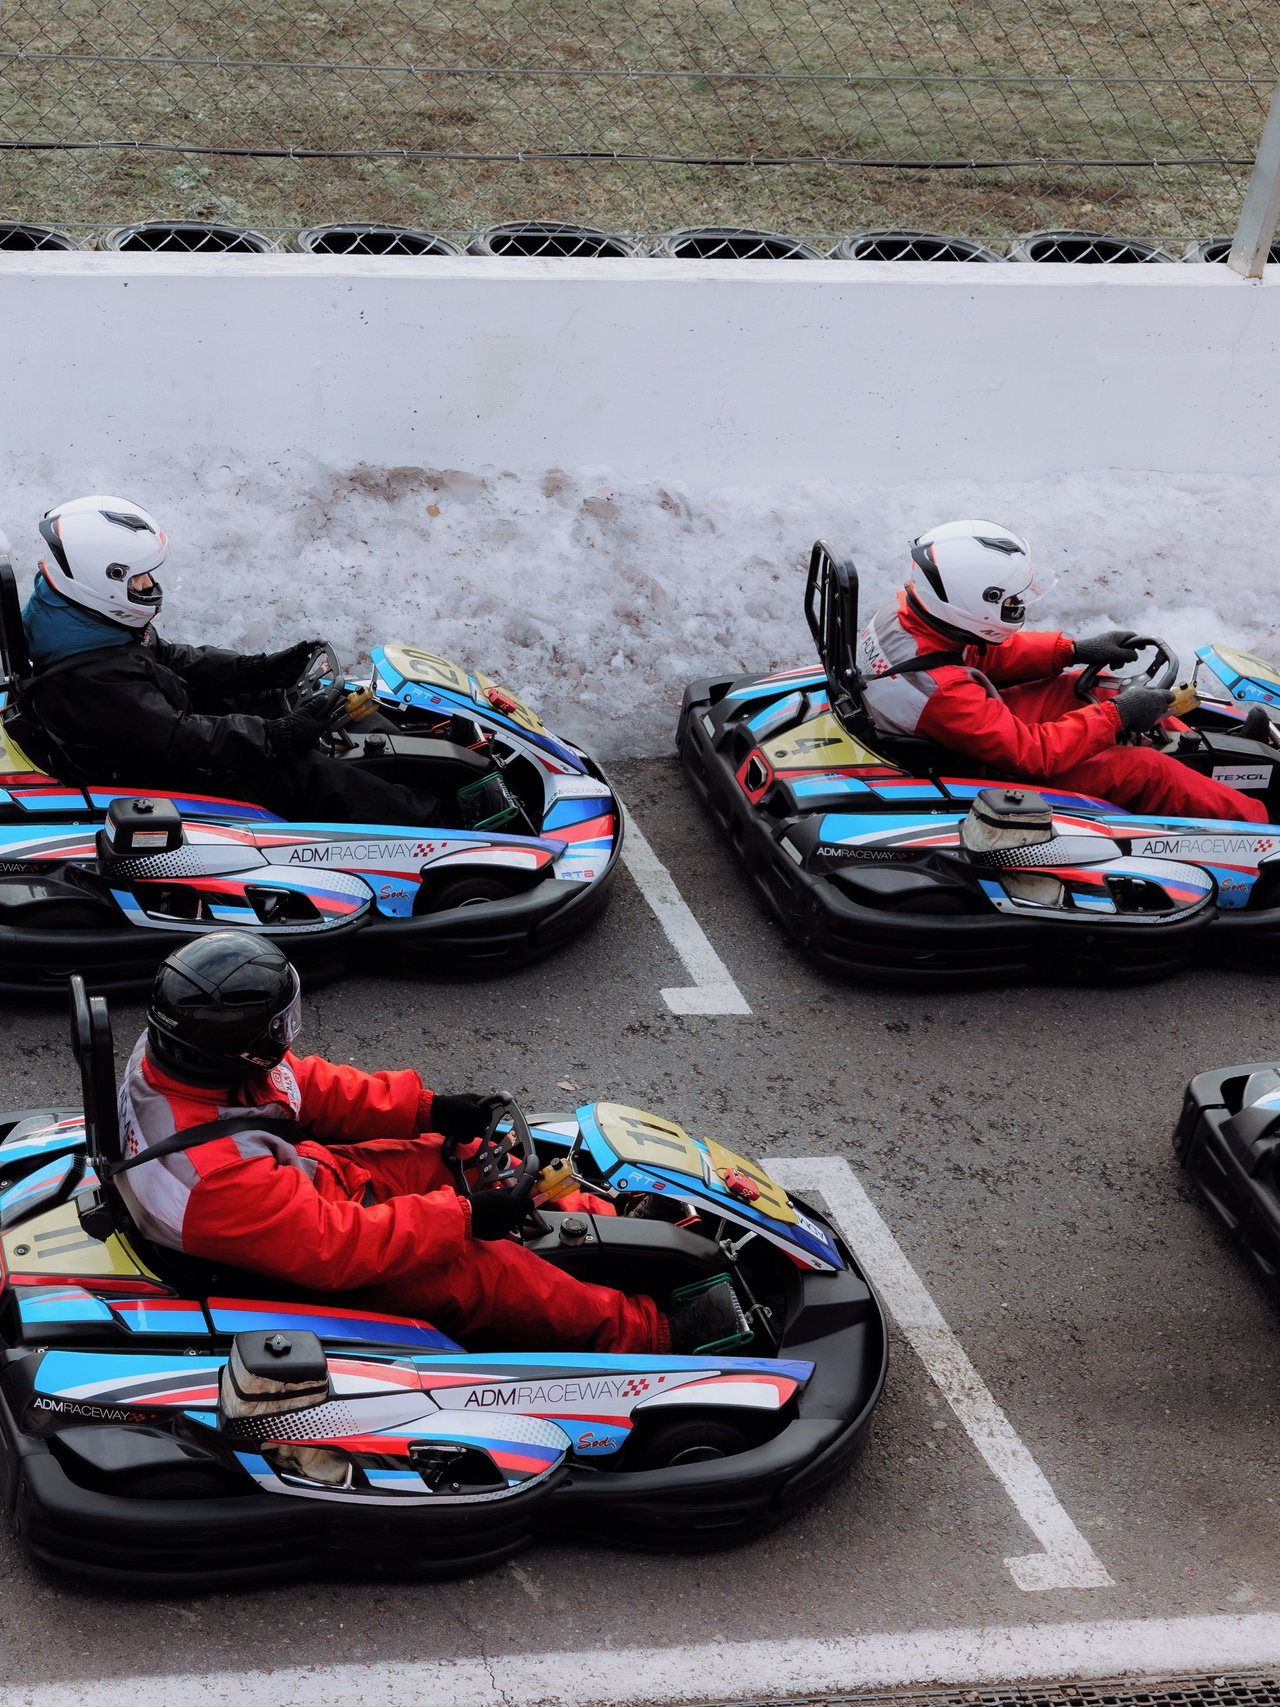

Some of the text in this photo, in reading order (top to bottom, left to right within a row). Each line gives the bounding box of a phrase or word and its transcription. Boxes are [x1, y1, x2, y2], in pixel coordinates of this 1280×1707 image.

[401, 648, 461, 686] 20
[411, 687, 442, 705] RT8
[790, 737, 844, 755] 4
[289, 843, 417, 864] ADMRACEWAY
[816, 846, 895, 861] ADMRACEWAY
[1142, 839, 1257, 855] ADMRACEWAY
[561, 869, 595, 880] RT8
[619, 1115, 688, 1155] 11
[627, 1171, 667, 1191] RT8
[464, 1379, 626, 1408] ADMRACEWAY
[33, 1397, 131, 1421] ADMRACEWAY
